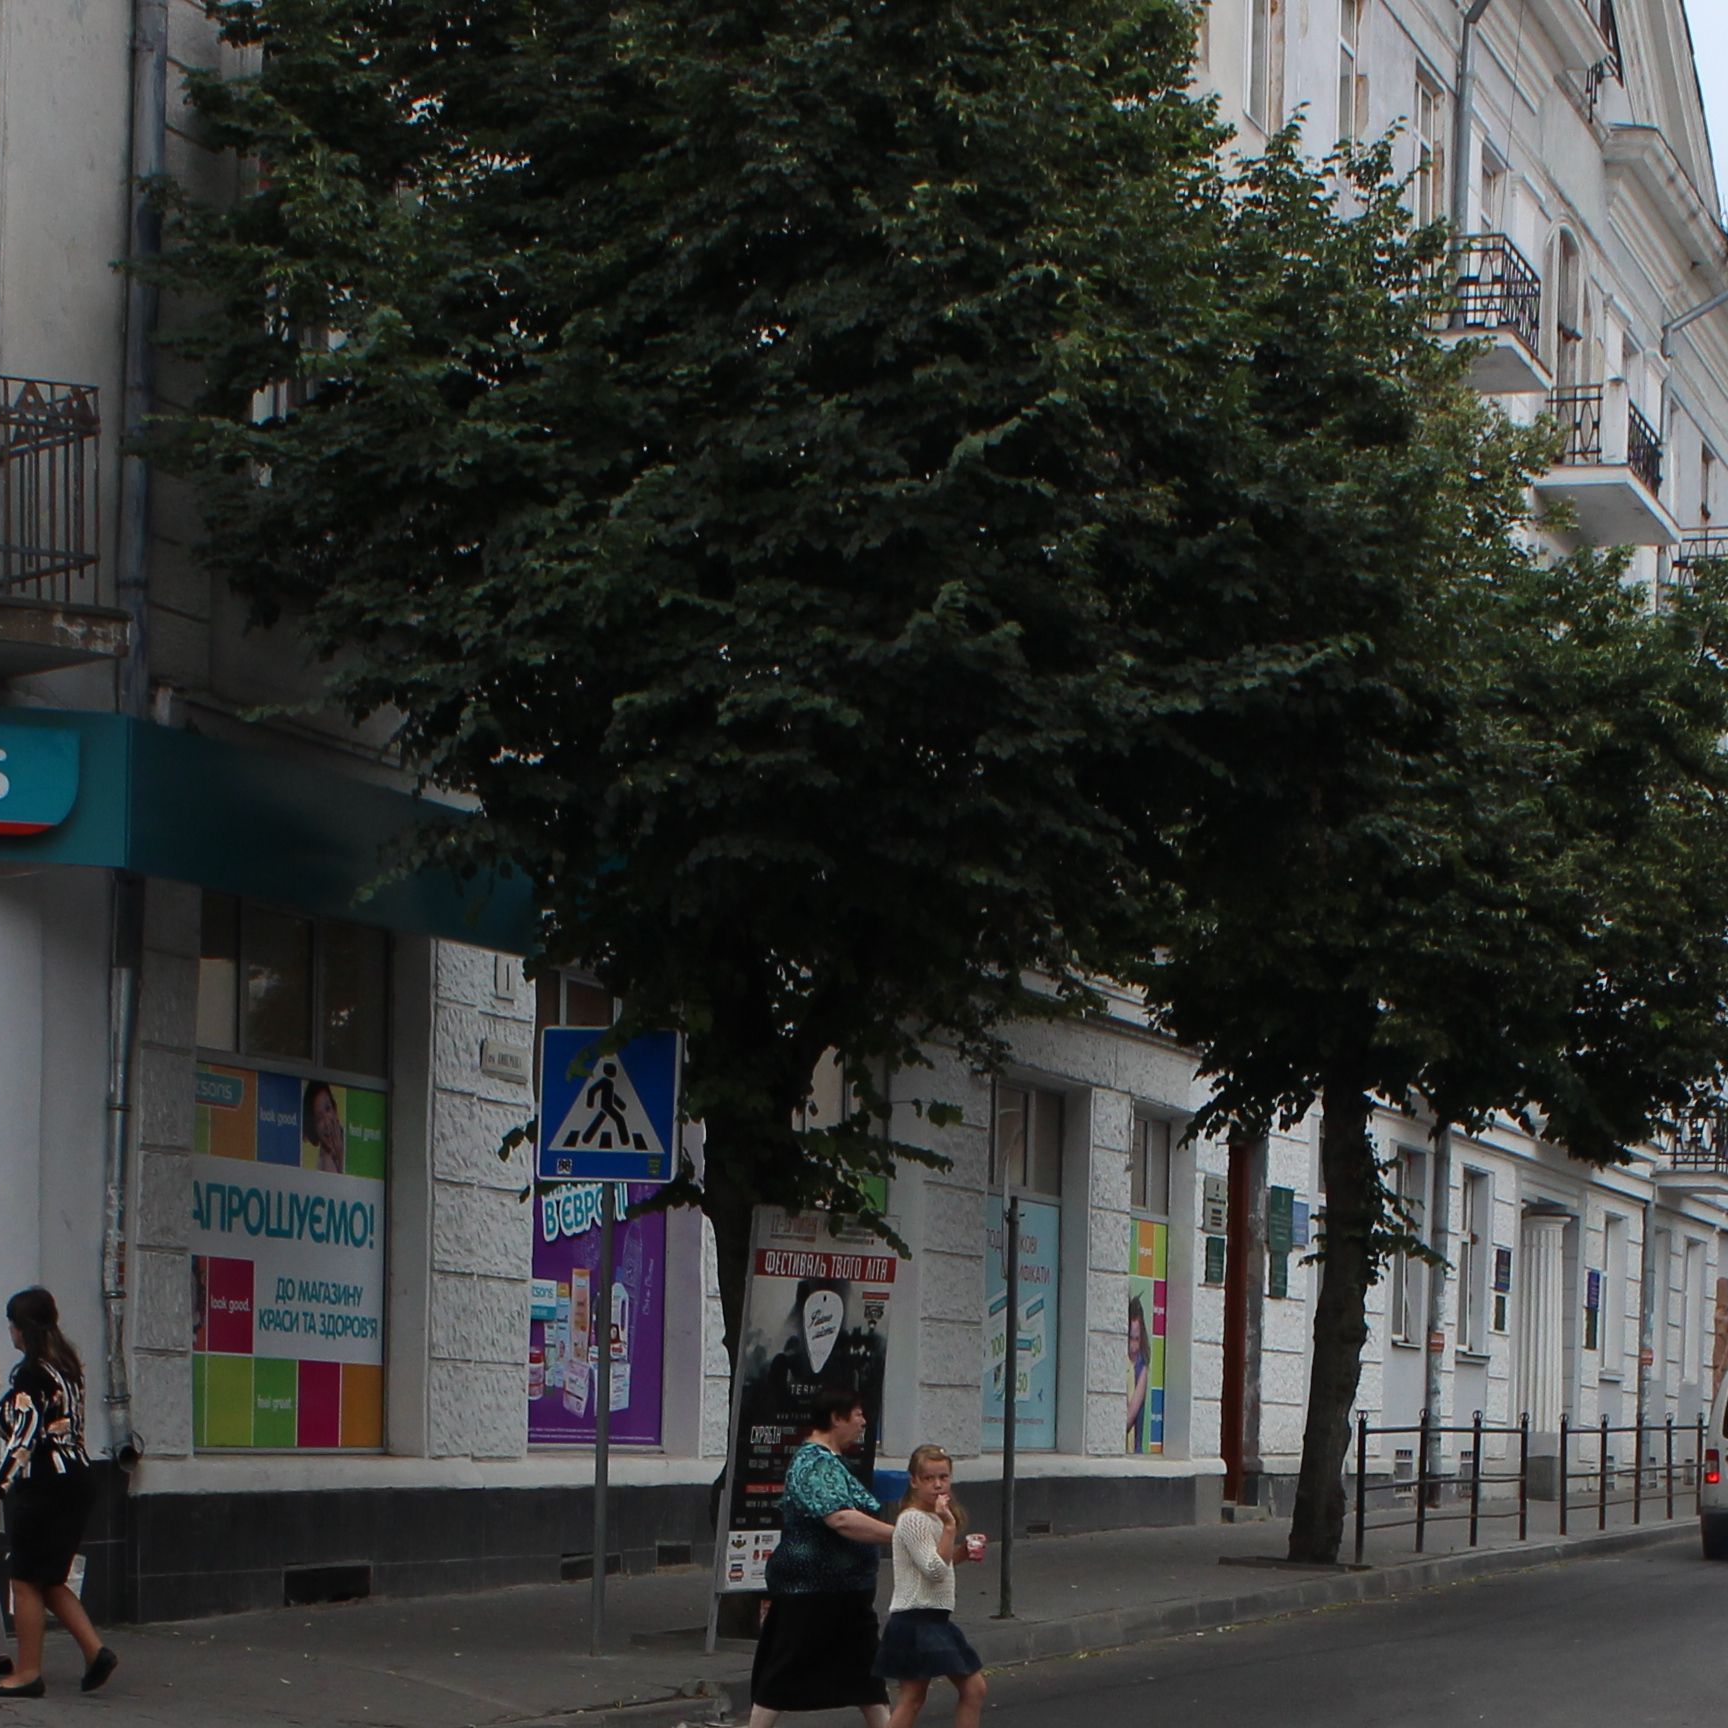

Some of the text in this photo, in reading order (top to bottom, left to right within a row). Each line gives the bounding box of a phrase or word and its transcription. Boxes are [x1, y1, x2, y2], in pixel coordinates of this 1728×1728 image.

[764, 1251, 888, 1281] ФЕСТИВАЛЬ ТВОГО ЛІТА
[210, 1295, 226, 1311] look
[275, 1276, 364, 1308] ДО МАГАЗИНУ
[258, 1308, 300, 1334] КРАСИ
[302, 1310, 317, 1335] ТА
